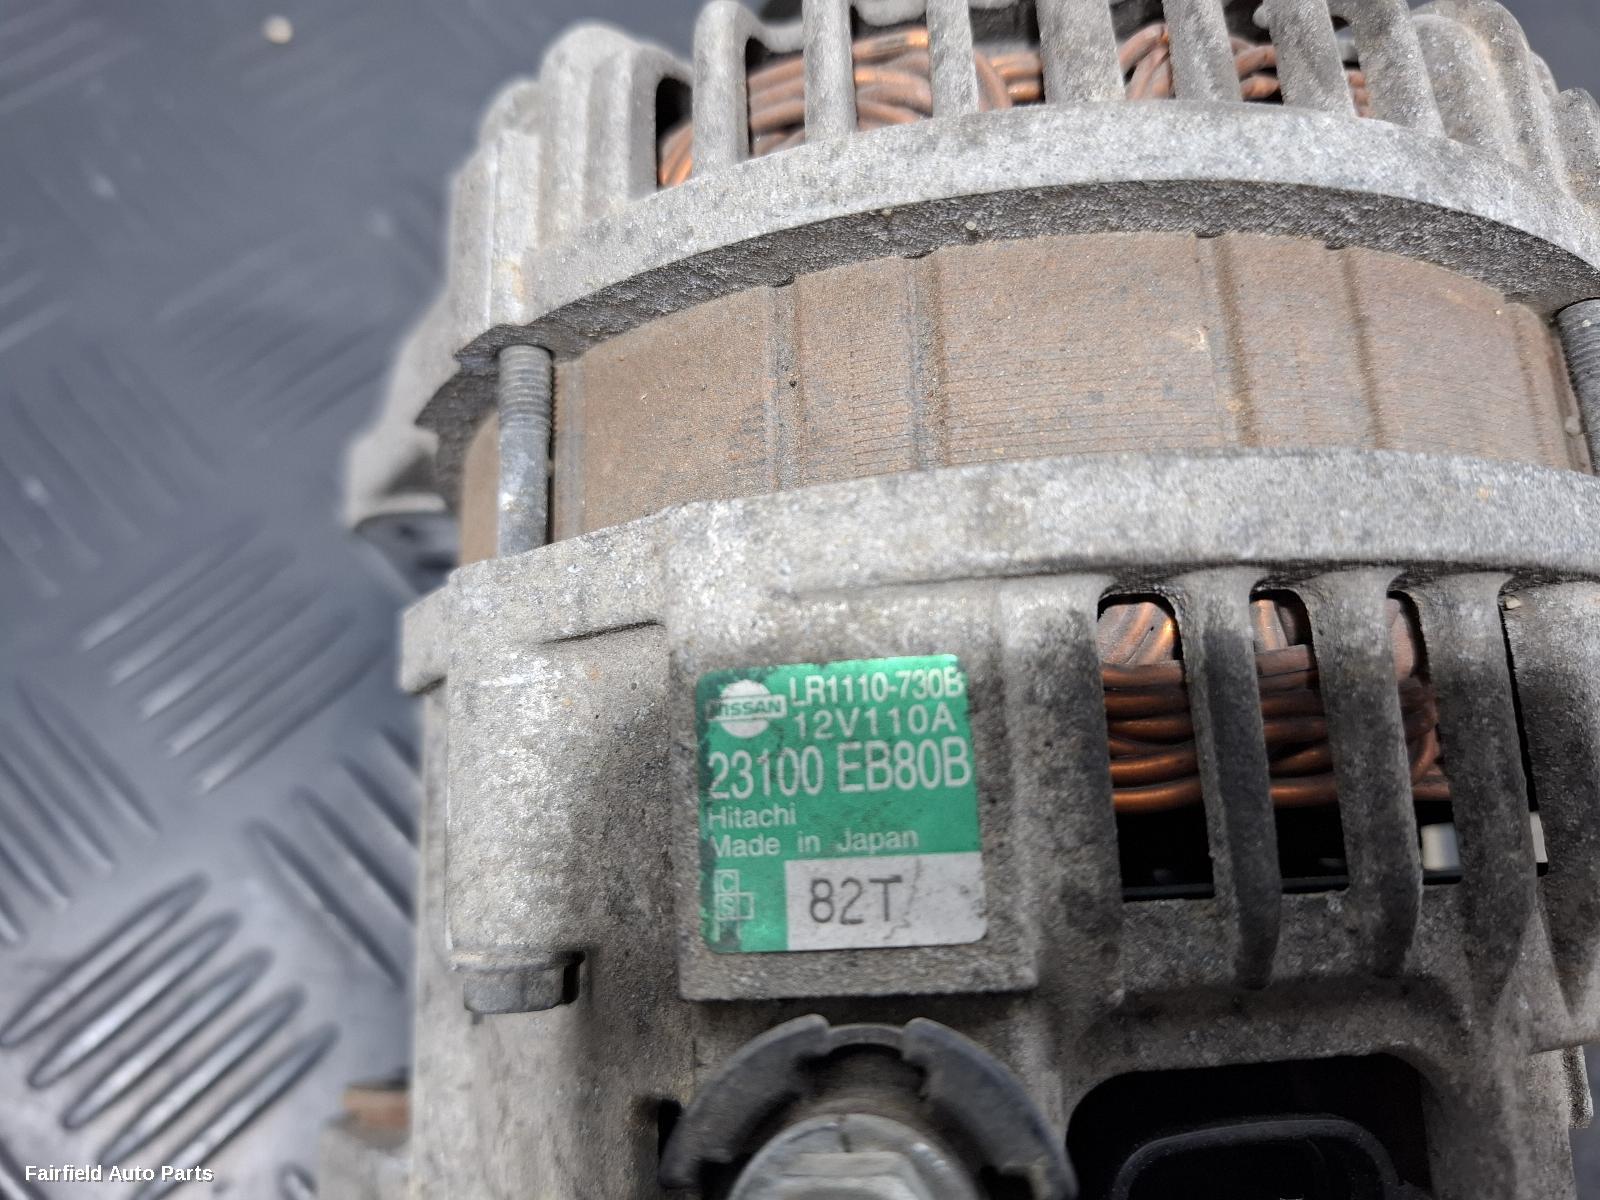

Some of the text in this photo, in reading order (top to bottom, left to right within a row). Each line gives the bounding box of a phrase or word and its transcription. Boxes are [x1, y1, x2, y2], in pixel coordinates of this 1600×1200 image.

[789, 667, 964, 706] LR1110-730B
[794, 701, 958, 740] 12V110A
[708, 736, 972, 799] 23100 EB80B
[708, 803, 797, 829] Hitachi
[711, 829, 919, 858] Made in Japan
[809, 874, 902, 925] 82T
